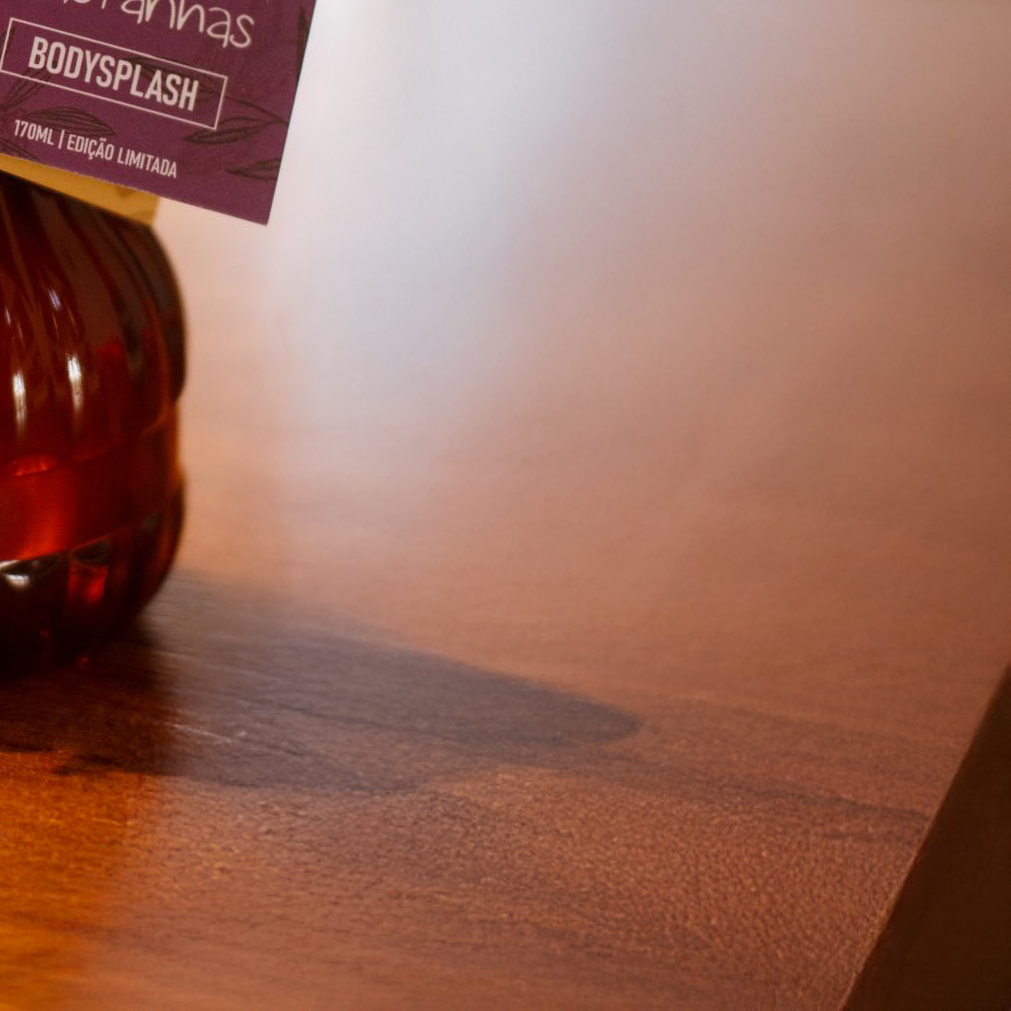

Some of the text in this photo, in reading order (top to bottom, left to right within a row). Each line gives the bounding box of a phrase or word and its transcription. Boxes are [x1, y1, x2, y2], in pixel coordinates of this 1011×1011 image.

[28, 36, 199, 111] BODYSPLASH
[14, 119, 54, 146] 170ML
[66, 134, 115, 160] EDIÇÃO
[117, 147, 178, 179] LIMITADA
